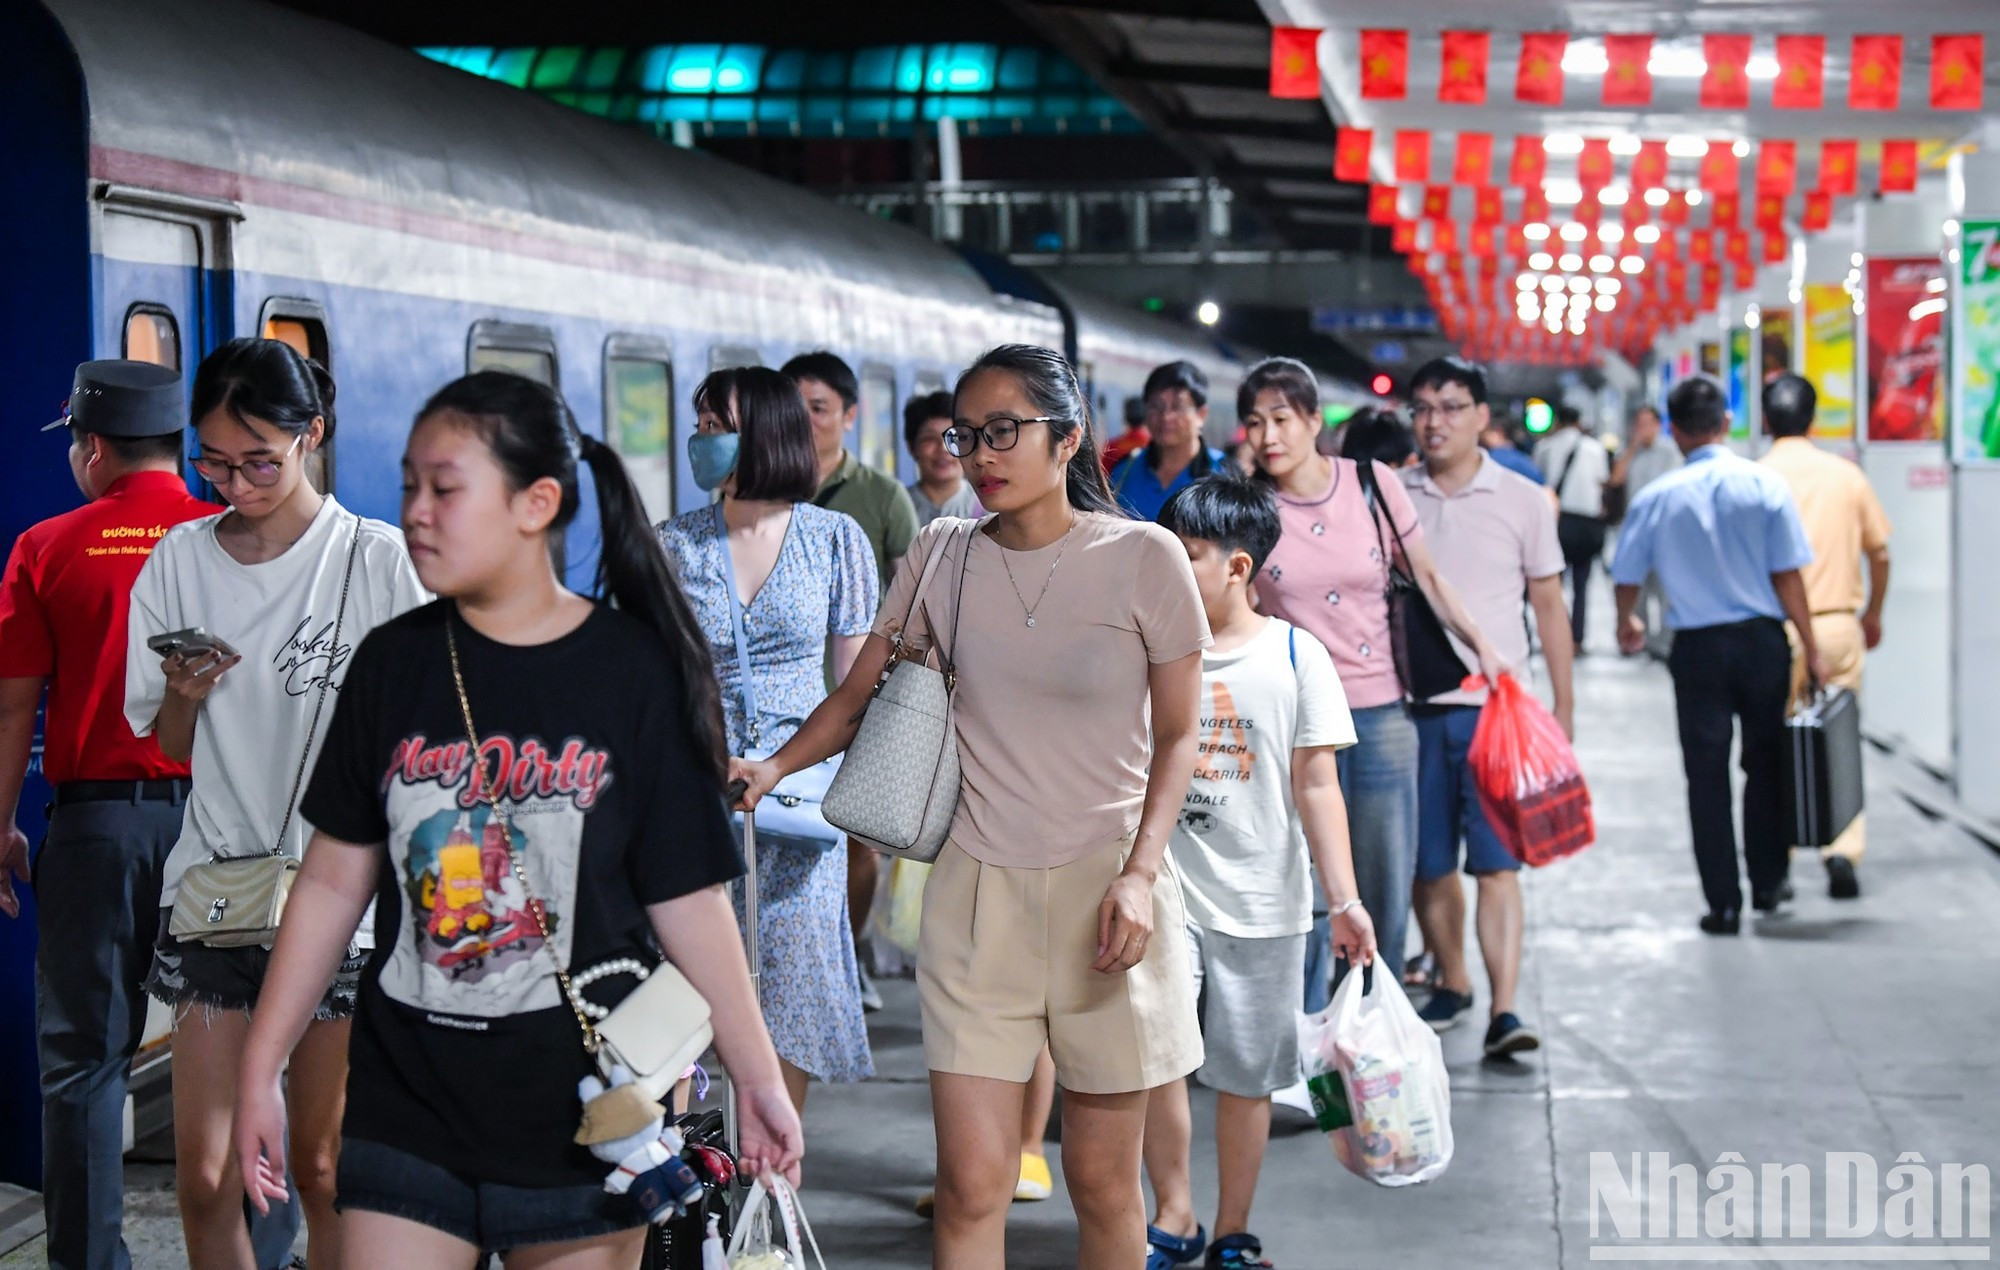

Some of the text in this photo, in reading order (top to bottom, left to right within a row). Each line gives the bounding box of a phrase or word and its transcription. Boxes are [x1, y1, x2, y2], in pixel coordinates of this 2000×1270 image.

[1967, 228, 2000, 284] 7
[1200, 718, 1254, 729] NGELES
[1199, 743, 1247, 754] BEACH
[459, 735, 613, 808] Dirty
[1193, 768, 1250, 780] CLARITA
[1186, 794, 1229, 806] NDALE
